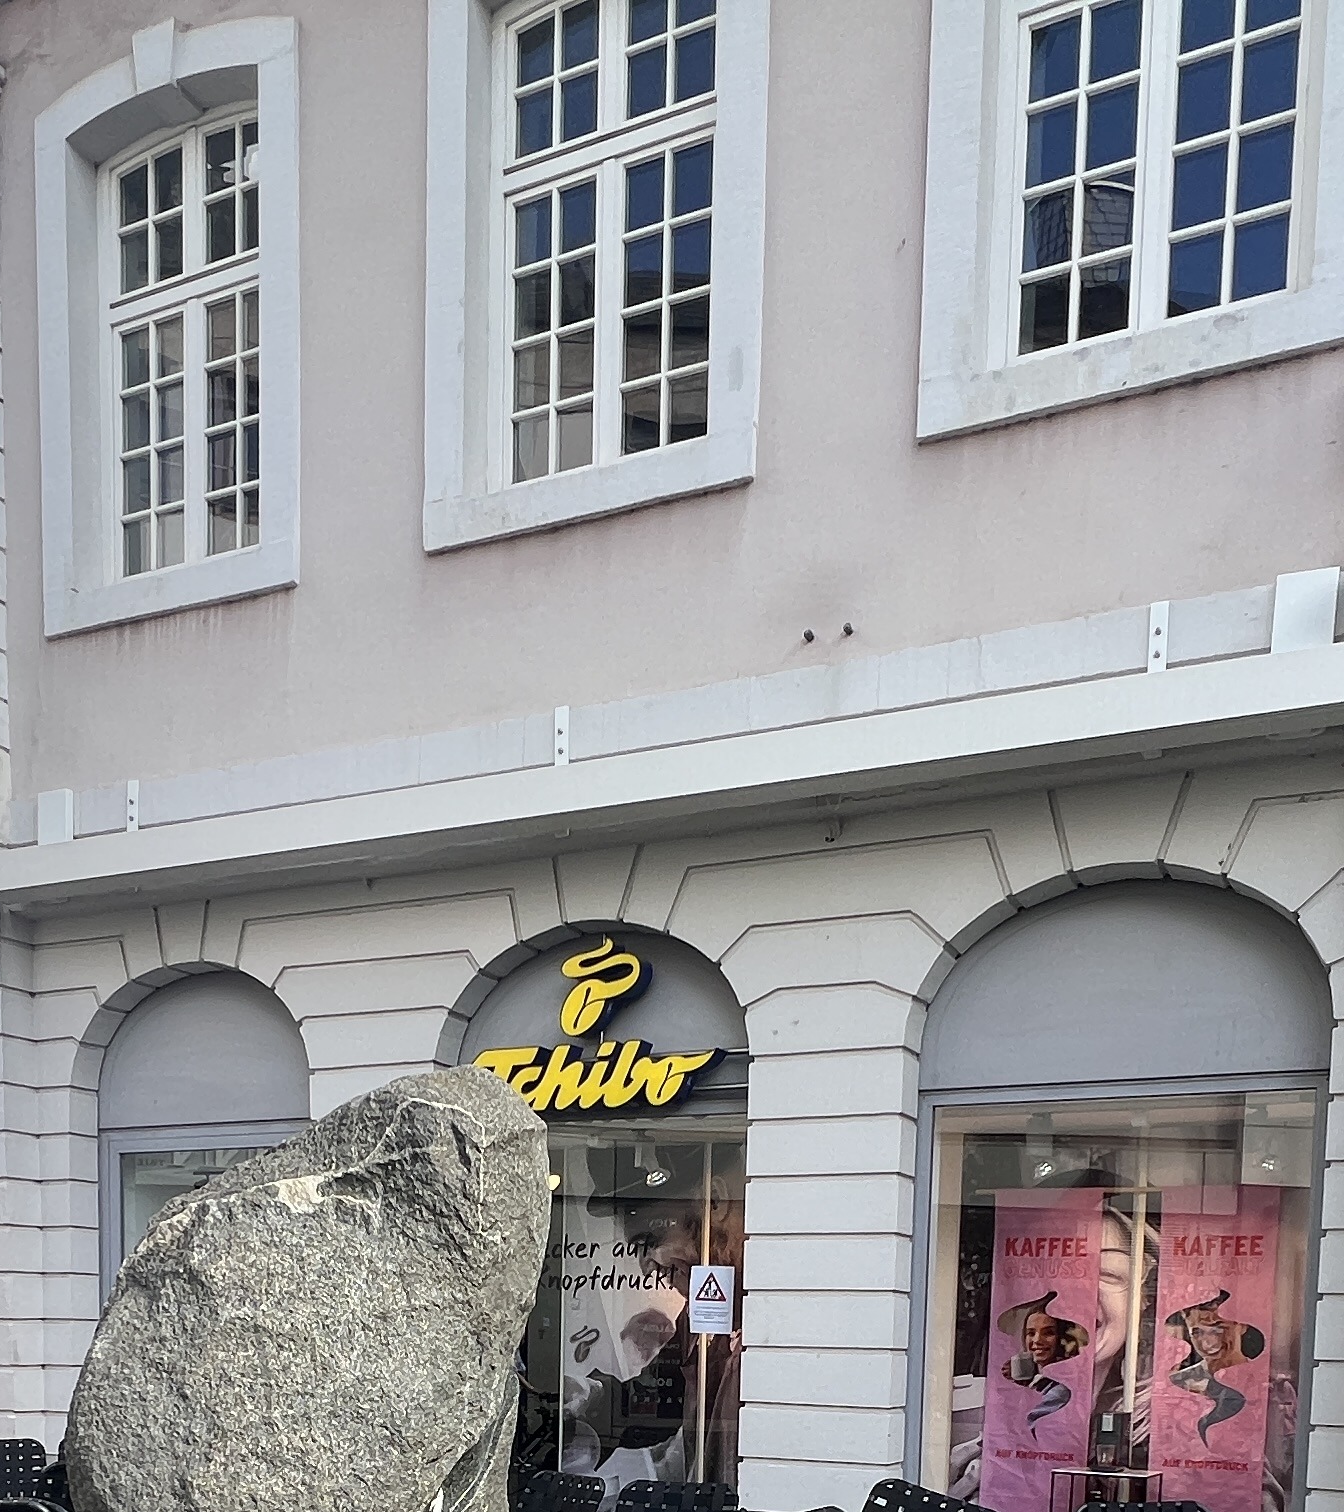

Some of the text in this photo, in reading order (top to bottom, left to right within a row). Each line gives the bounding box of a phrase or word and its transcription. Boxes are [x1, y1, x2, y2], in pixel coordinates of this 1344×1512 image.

[472, 1039, 716, 1112] Tchibo
[546, 1233, 601, 1259] cker
[1004, 1236, 1088, 1258] KAFFEE
[1172, 1235, 1265, 1257] KAFFEE
